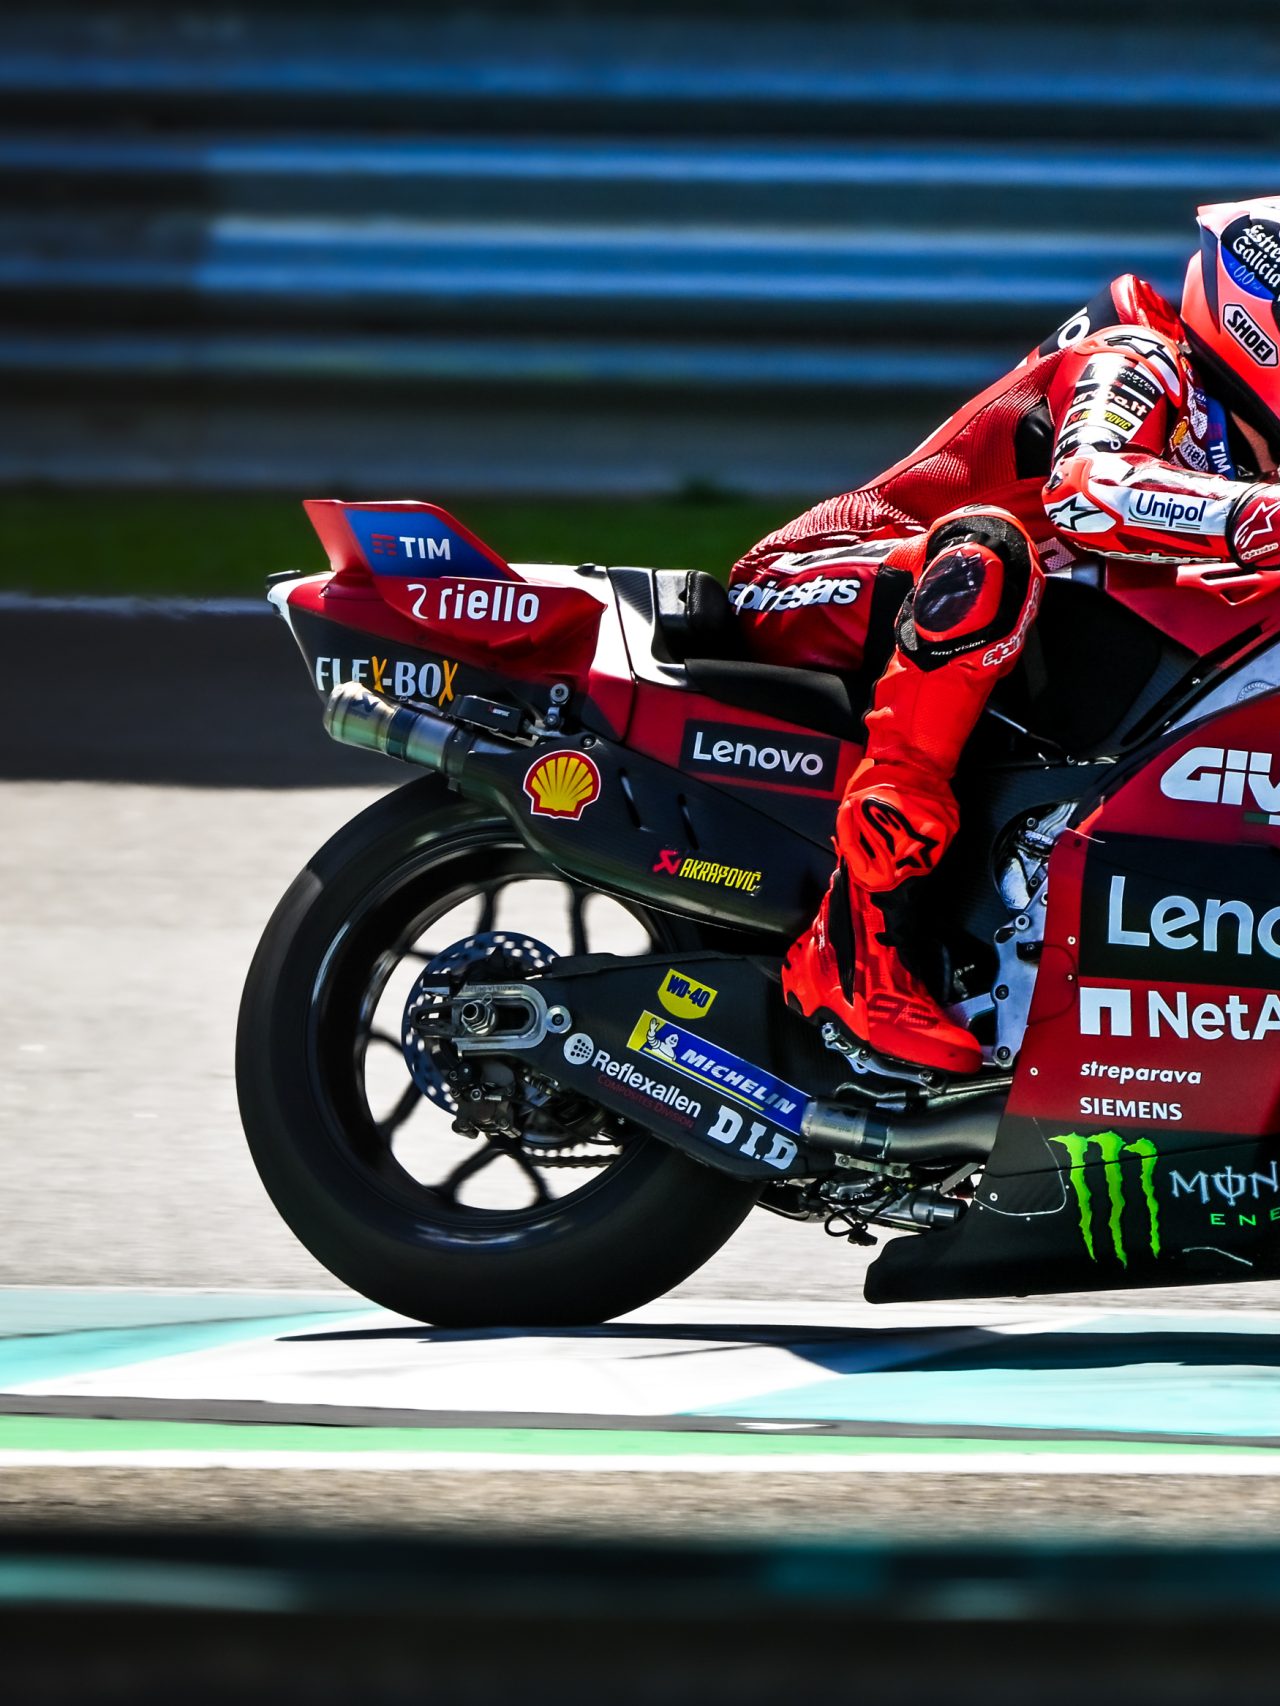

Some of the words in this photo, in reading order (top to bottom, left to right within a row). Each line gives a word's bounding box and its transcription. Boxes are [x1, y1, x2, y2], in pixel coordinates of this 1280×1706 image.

[1226, 310, 1272, 366] SHOEI
[1210, 442, 1231, 473] TIM
[1135, 493, 1207, 527] Unipol
[400, 536, 451, 561] TIM
[439, 583, 539, 623] riello
[693, 732, 823, 775] Lenovo
[666, 975, 711, 1008] WD-40
[591, 1049, 702, 1118] Reflexallen
[680, 1048, 797, 1115] MICHELIN
[1080, 1061, 1202, 1085] streparava
[1080, 1096, 1183, 1120] SIEMENS
